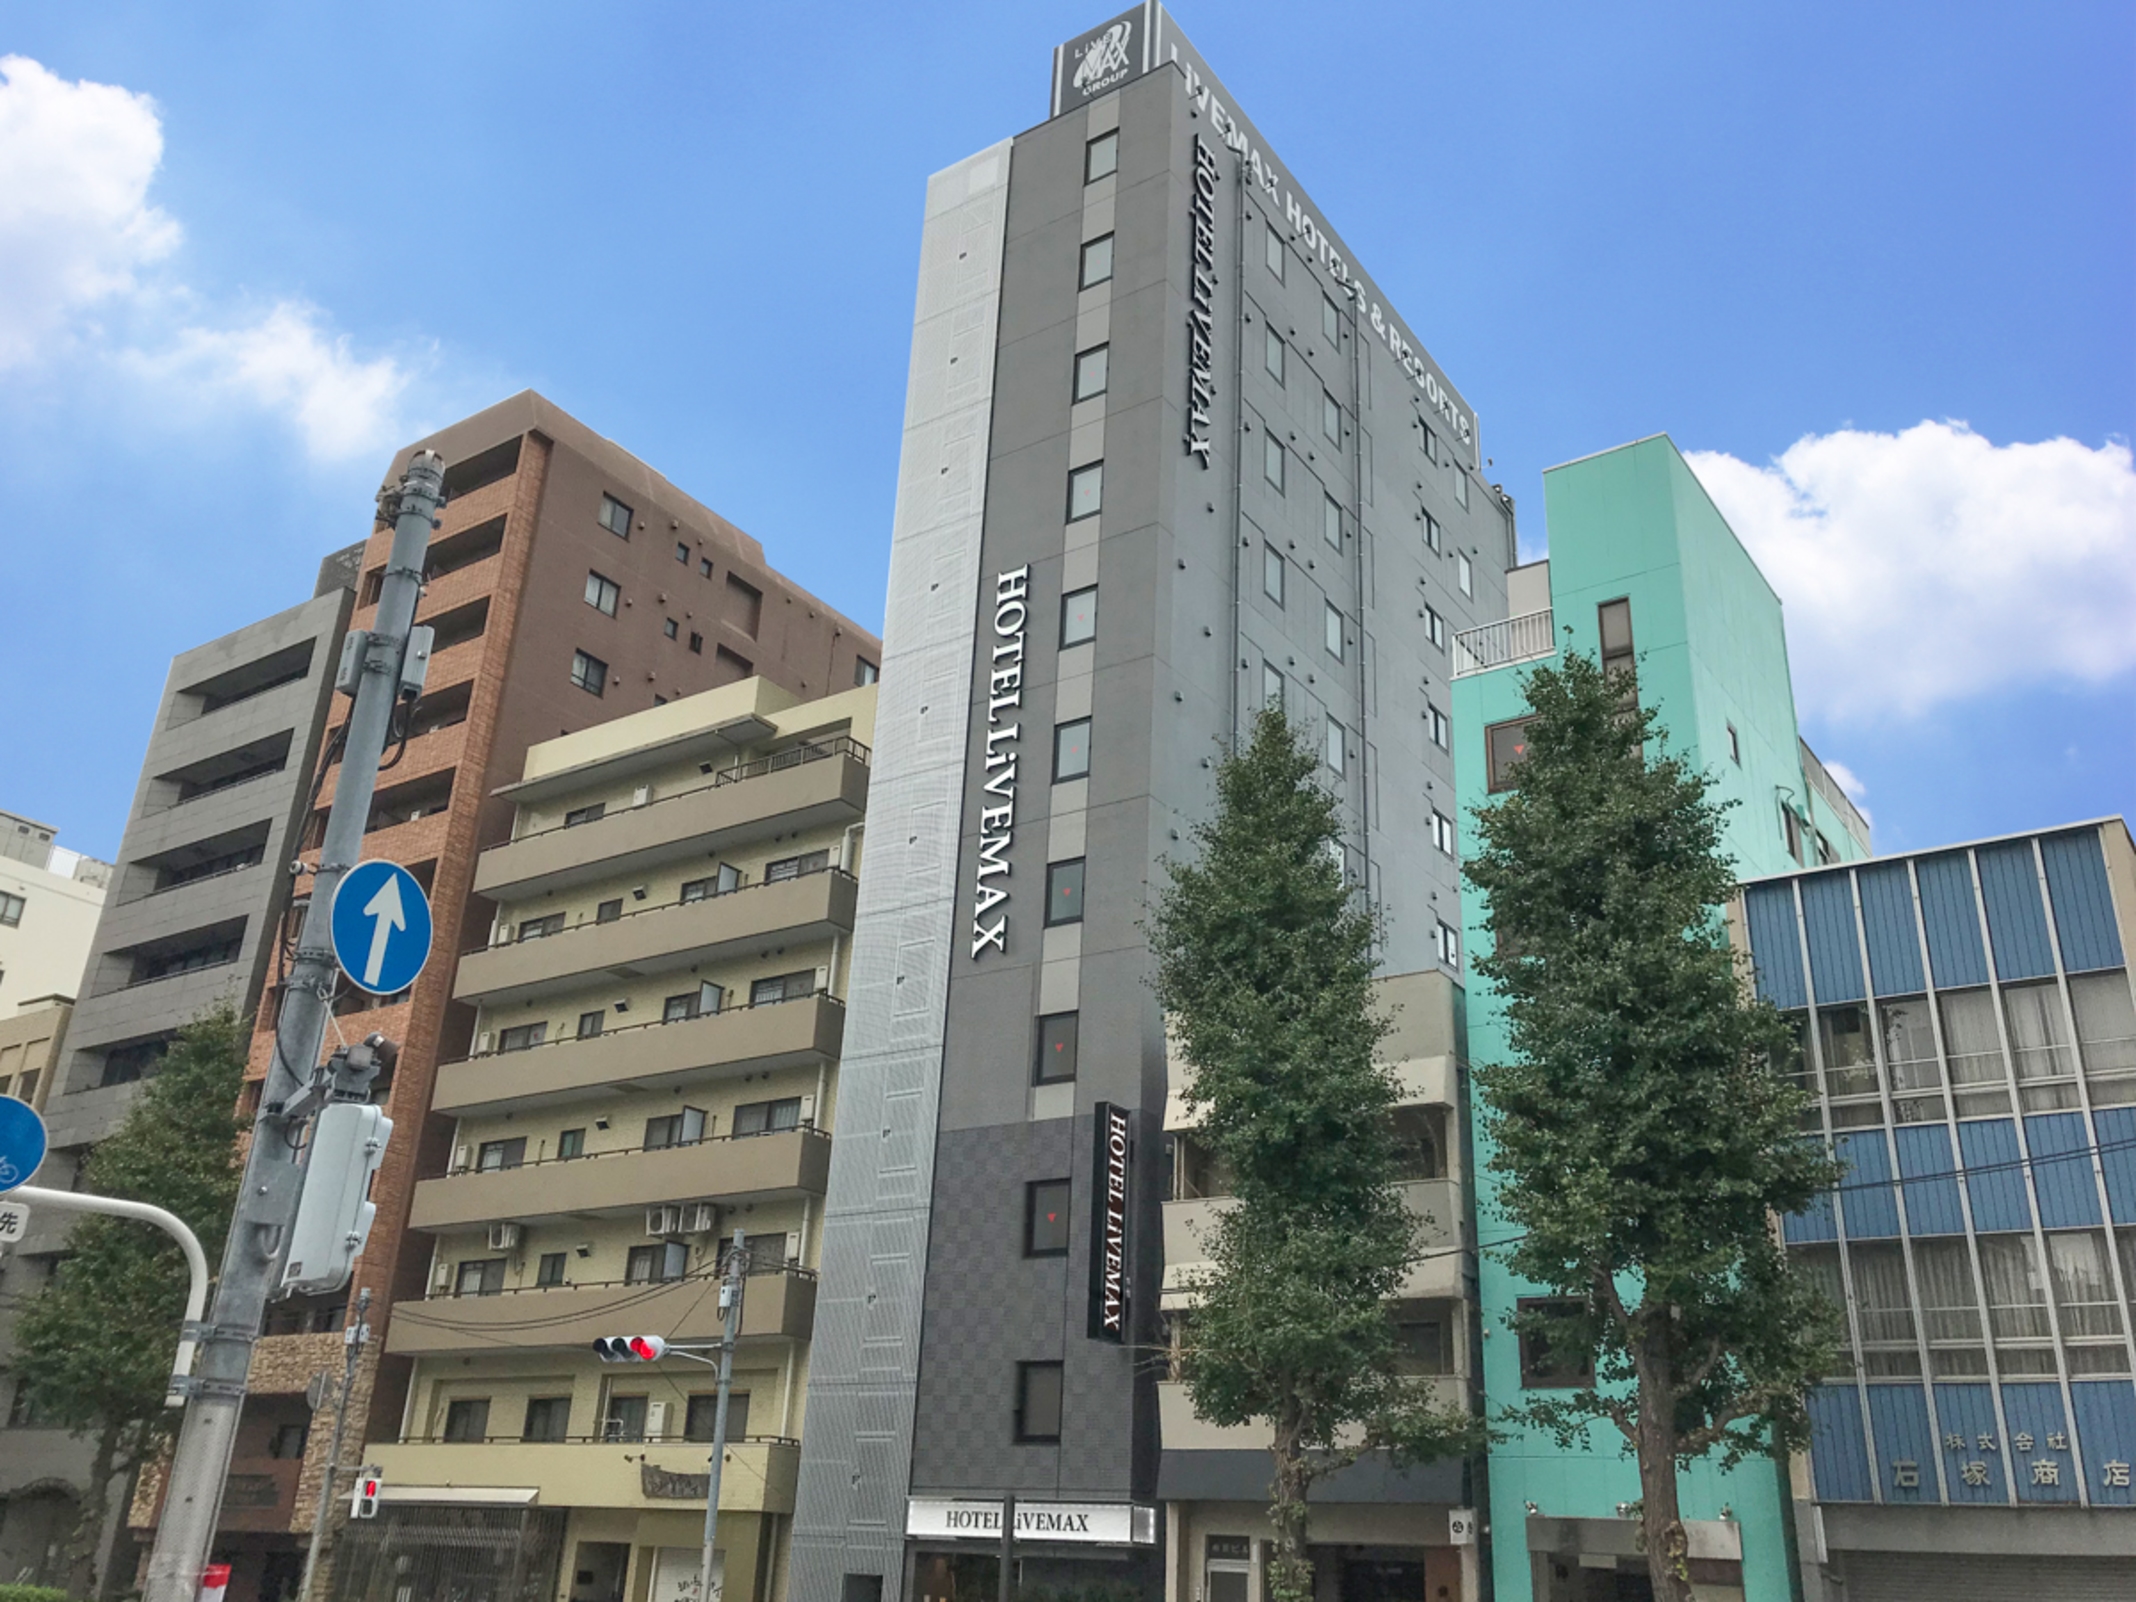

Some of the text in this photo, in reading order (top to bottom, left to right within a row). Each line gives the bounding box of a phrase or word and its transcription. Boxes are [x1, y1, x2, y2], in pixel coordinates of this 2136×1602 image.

[1082, 68, 1129, 96] GROUP
[1286, 190, 1367, 314] HOTELS
[1371, 303, 1387, 340] &
[1389, 323, 1472, 445] RESORTS
[971, 563, 1029, 959] HOTEL LiVEMAX
[1104, 1112, 1126, 1331] HOTEL LiVEMAX
[1945, 1432, 2070, 1450] 株式会社
[1892, 1458, 2130, 1486] 石塚商店
[946, 1510, 1088, 1532] HOTEL iVEMAX
